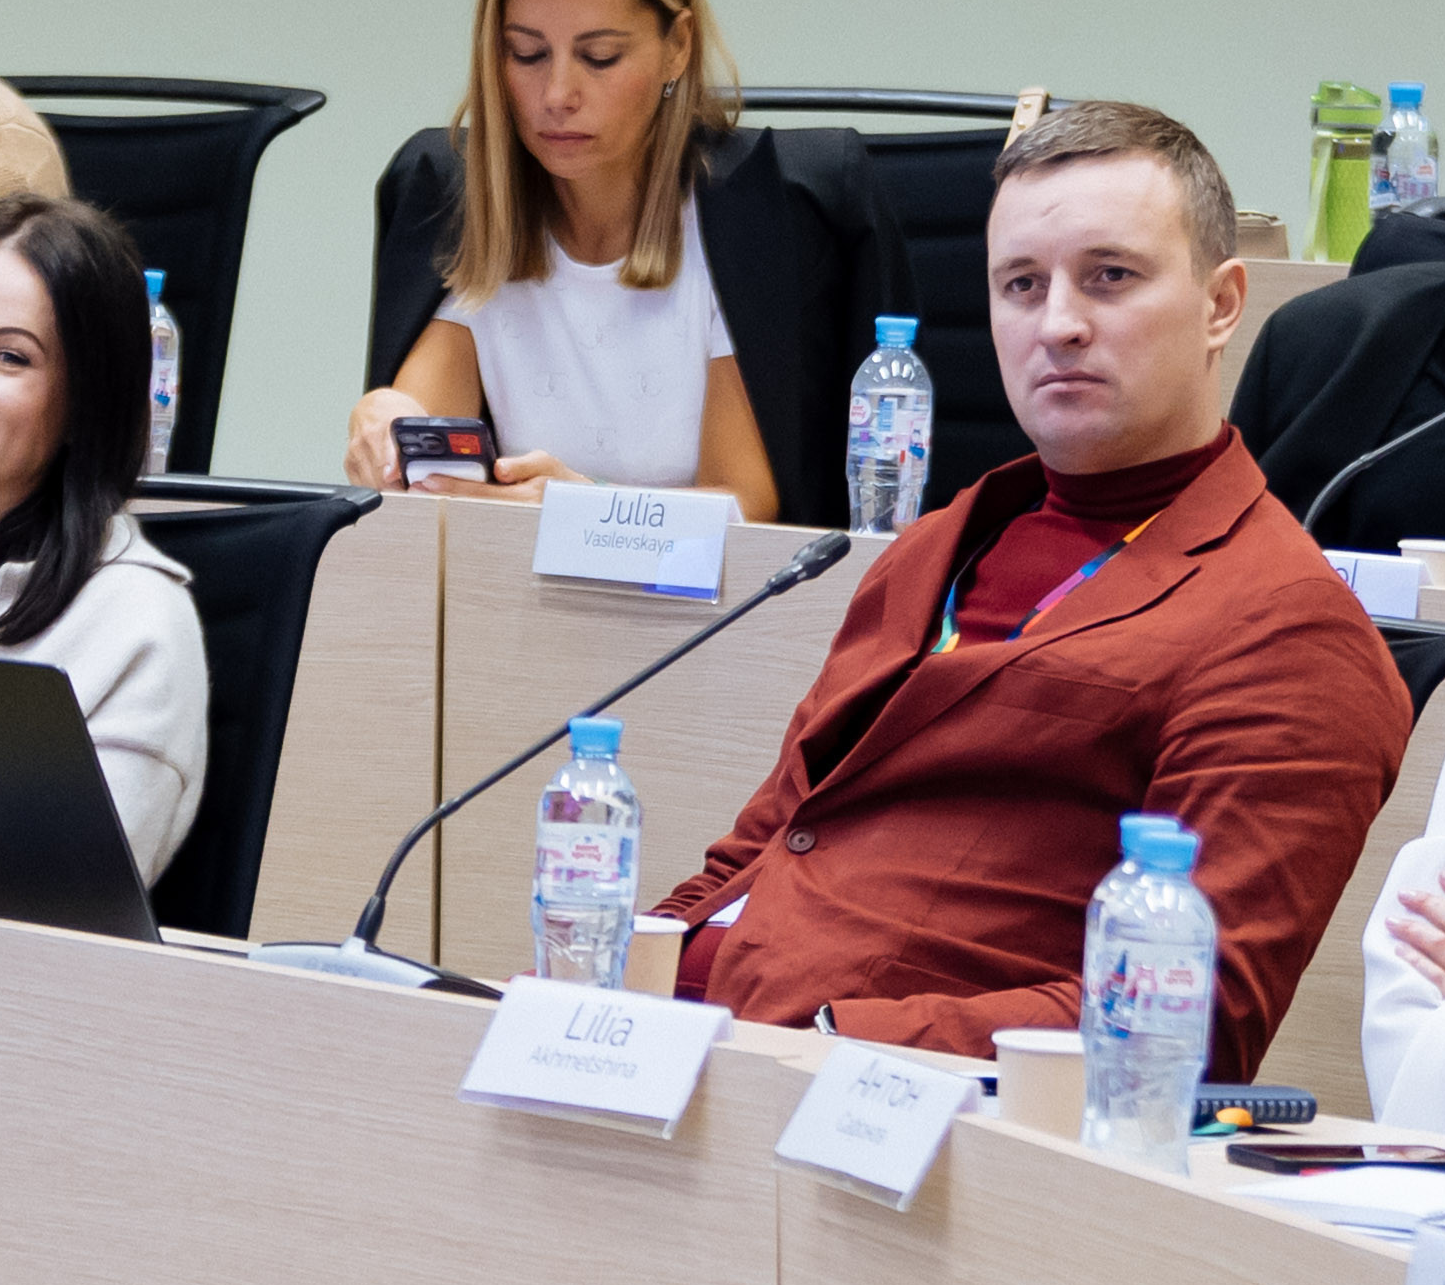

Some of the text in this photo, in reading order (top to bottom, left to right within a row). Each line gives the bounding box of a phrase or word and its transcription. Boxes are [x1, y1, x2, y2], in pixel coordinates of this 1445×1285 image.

[599, 492, 665, 527] Julia
[583, 529, 675, 557] Vasilevskaya
[564, 1002, 634, 1047] Lilia
